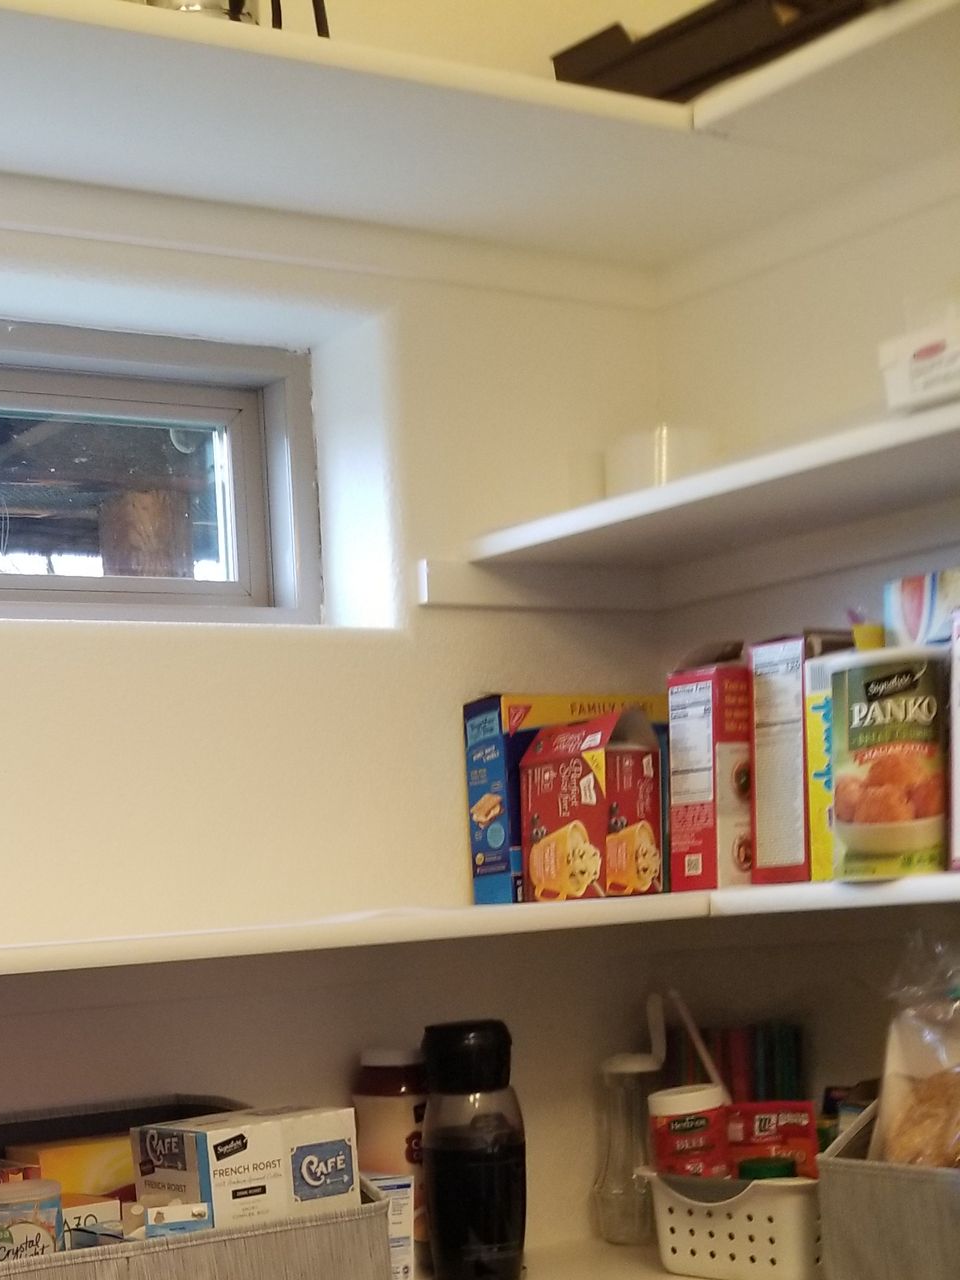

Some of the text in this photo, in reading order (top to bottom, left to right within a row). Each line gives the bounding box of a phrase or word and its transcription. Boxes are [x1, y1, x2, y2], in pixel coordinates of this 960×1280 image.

[569, 702, 617, 716] FAMILY
[850, 694, 938, 729] PANKO
[146, 1129, 179, 1166] CAFÉ
[212, 1158, 283, 1179] FRENCH ROAST
[300, 1150, 346, 1187] CAFÉ
[144, 1180, 187, 1193] FRENCH ROAST
